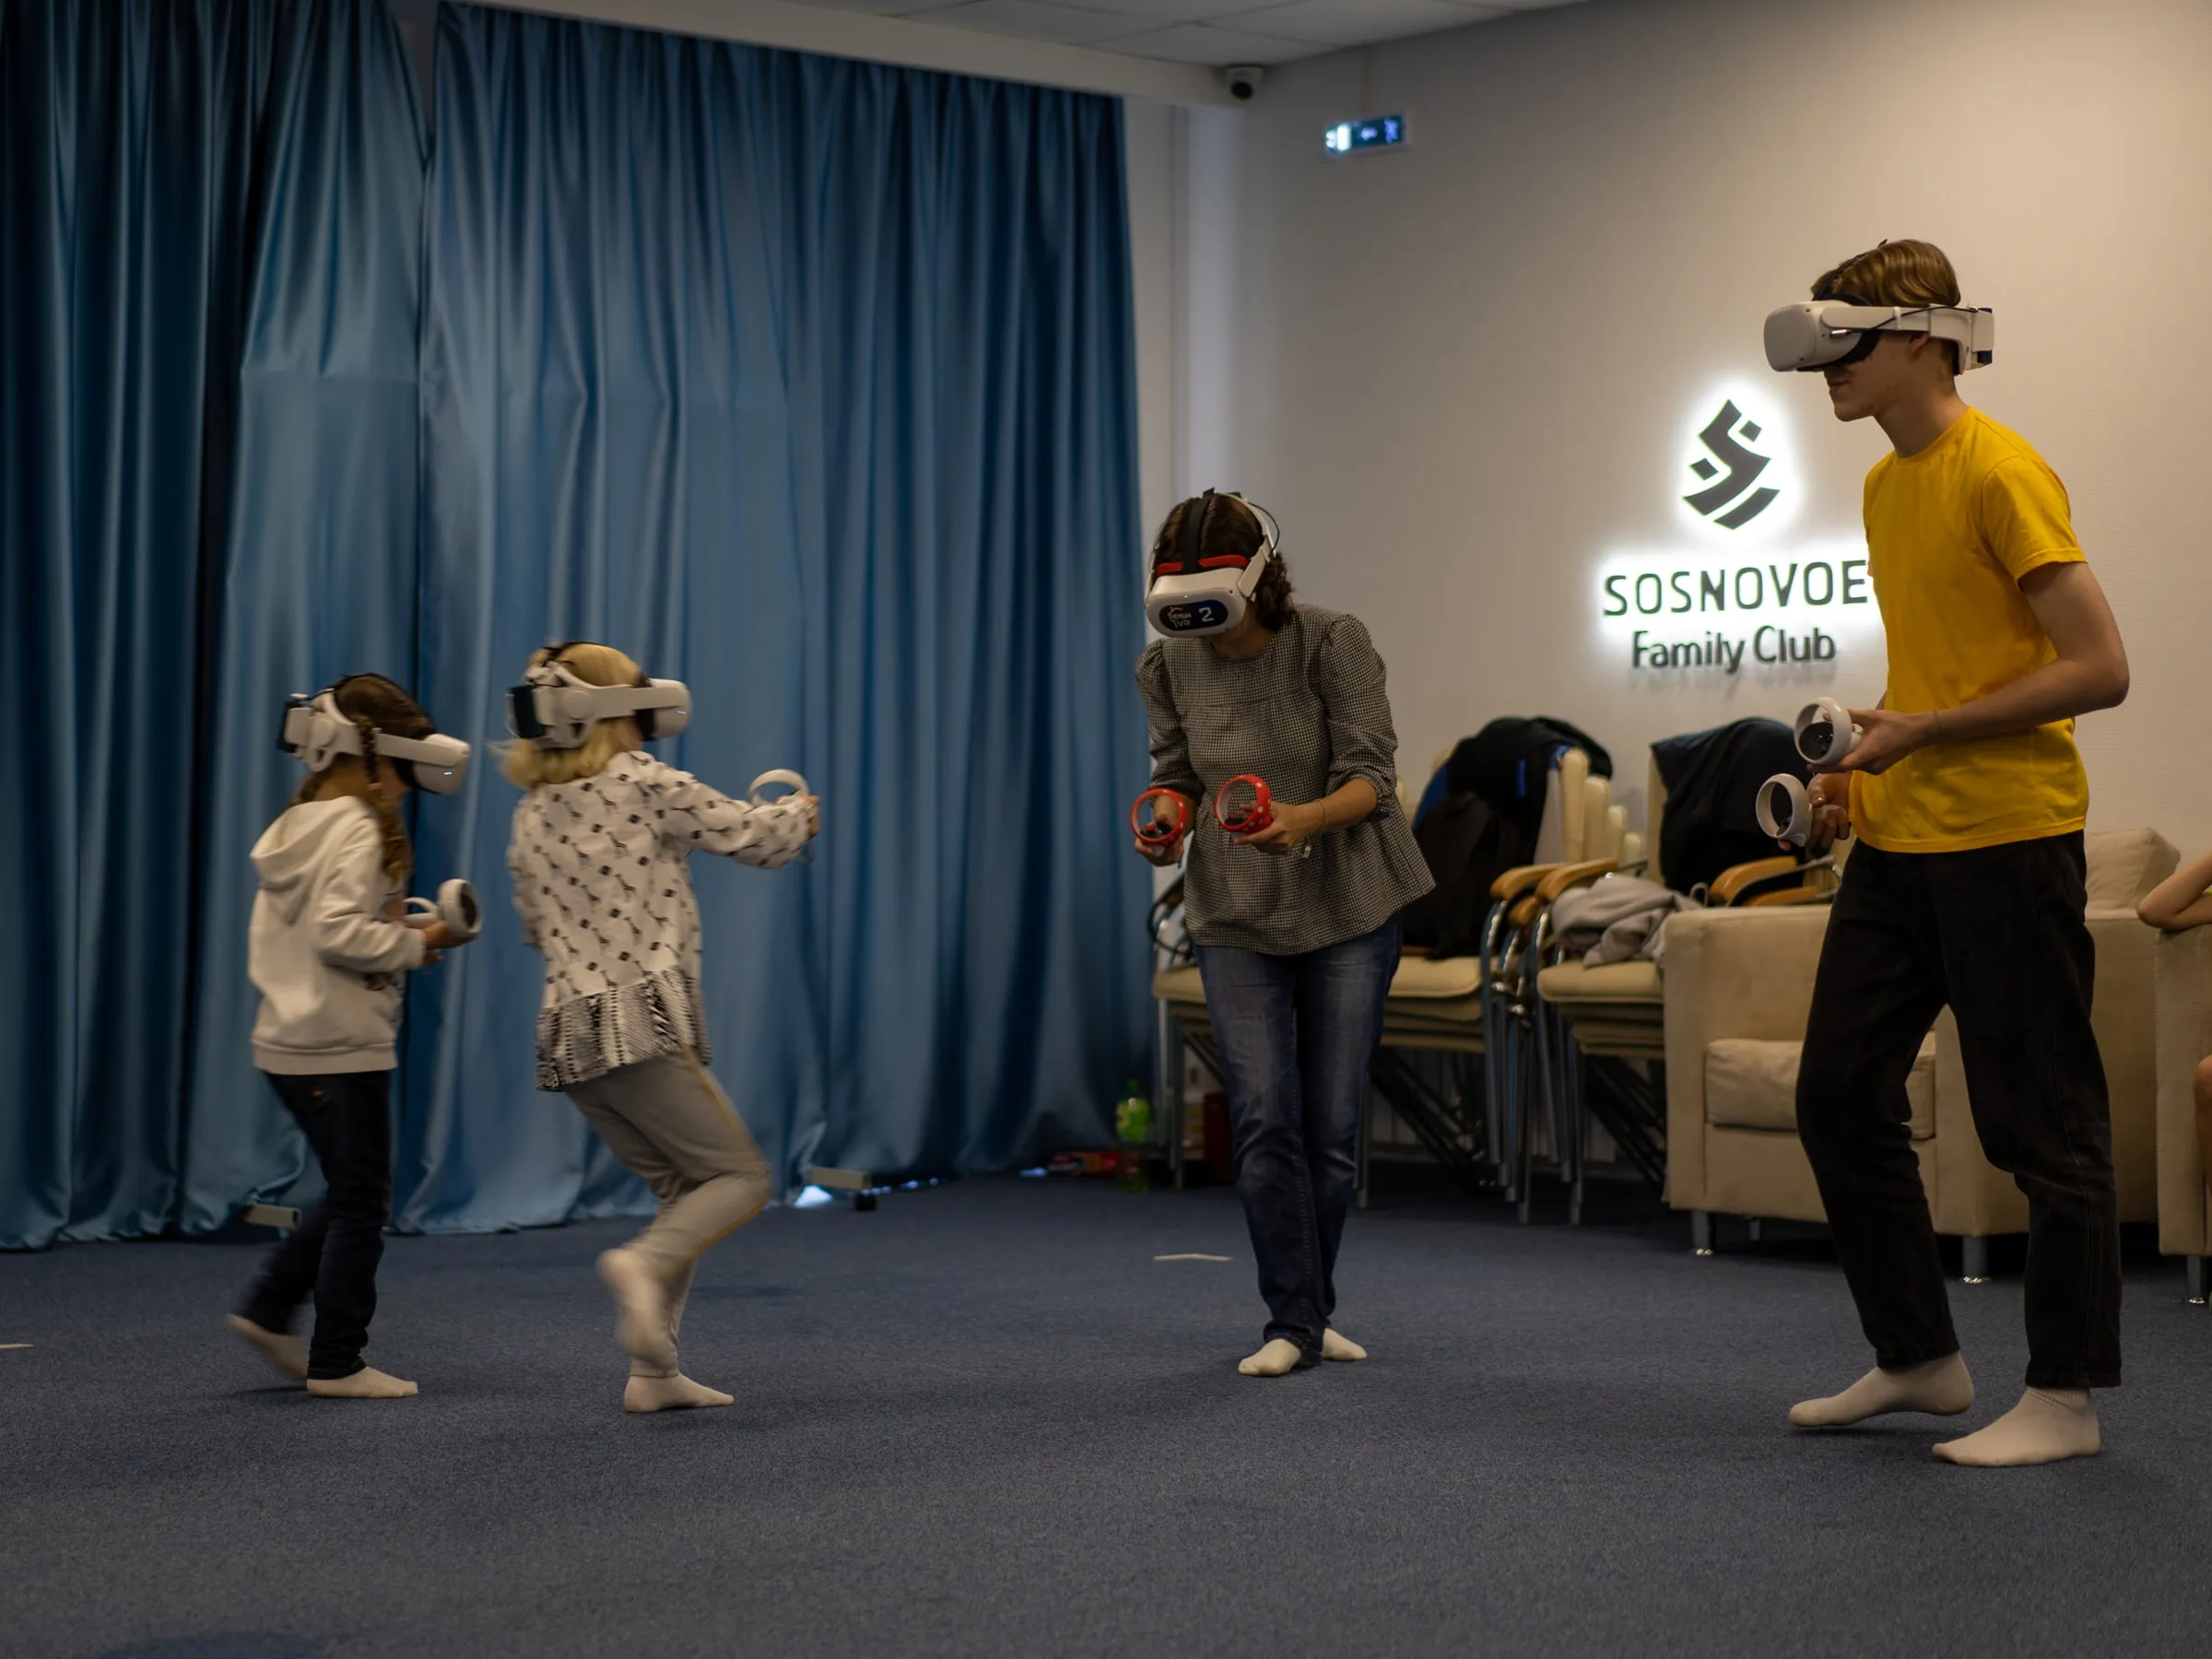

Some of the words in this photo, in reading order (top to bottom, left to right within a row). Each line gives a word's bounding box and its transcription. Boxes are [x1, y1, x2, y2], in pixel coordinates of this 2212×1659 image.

[1604, 559, 1868, 617] SOSNOVOE
[1198, 606, 1214, 622] 2
[1632, 630, 1745, 675] Family
[1754, 625, 1836, 663] Club
